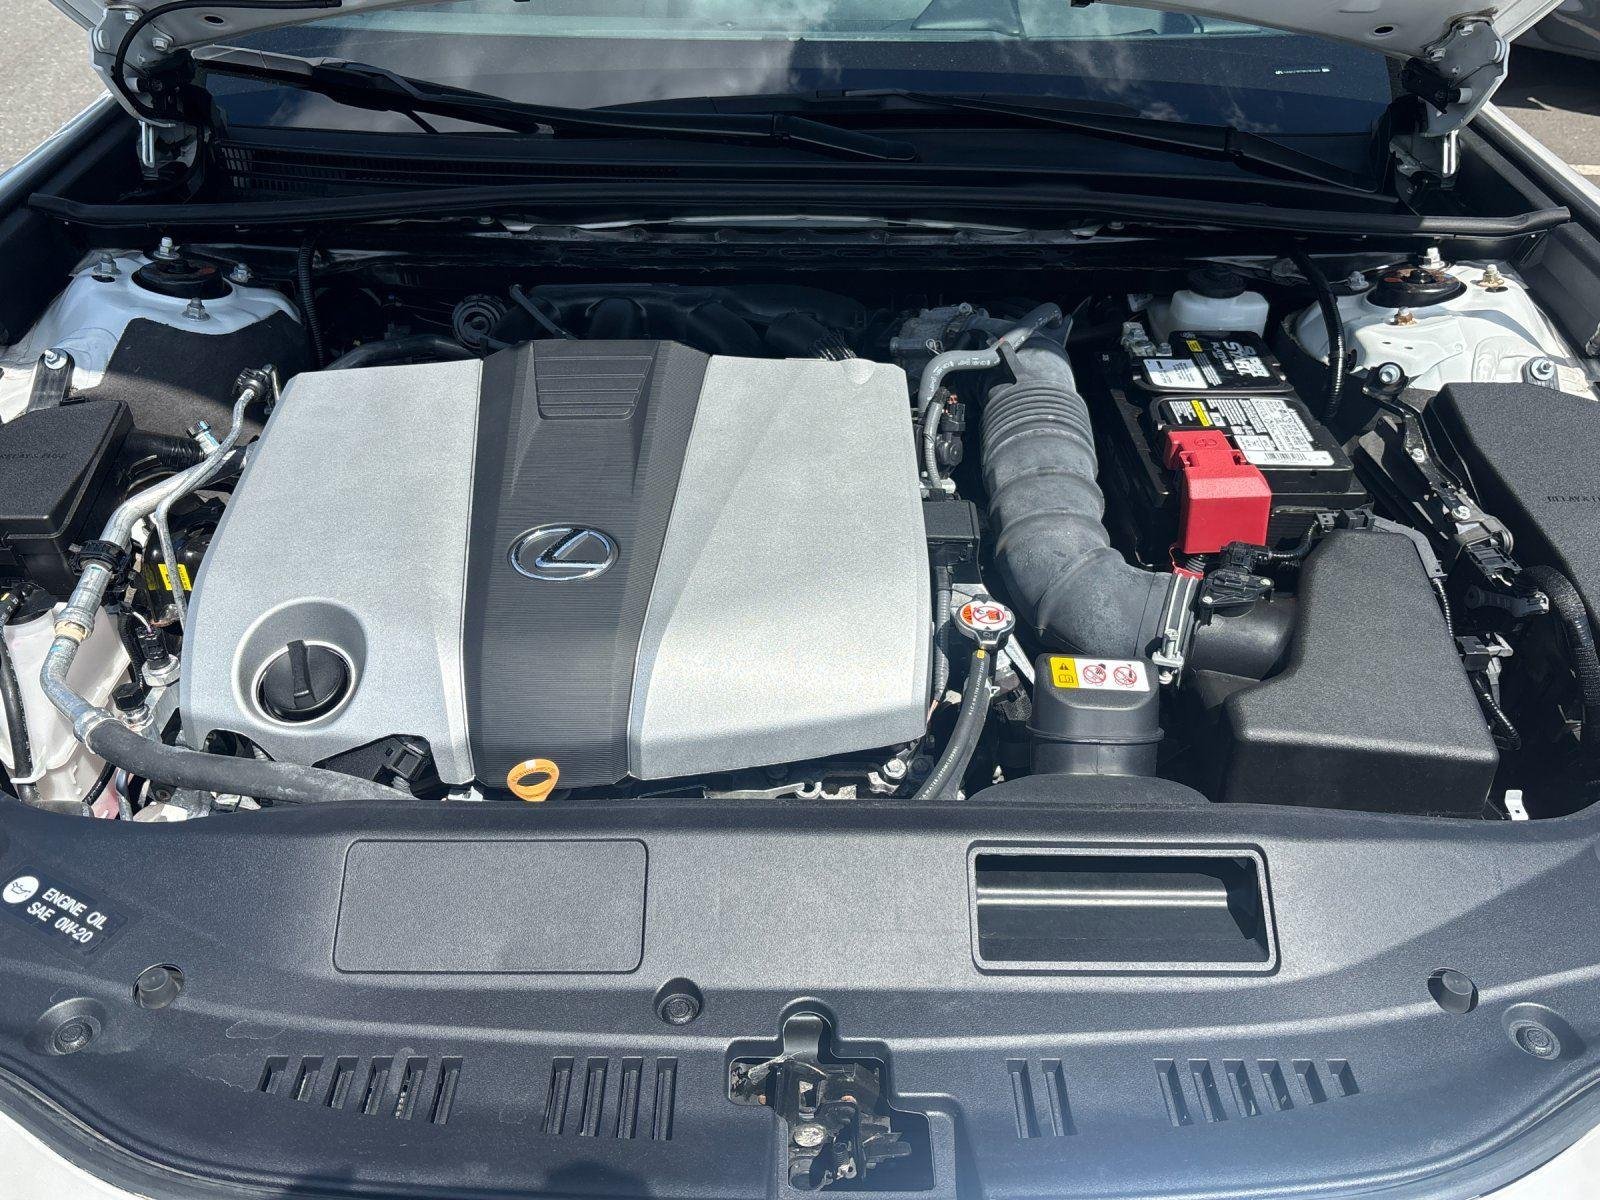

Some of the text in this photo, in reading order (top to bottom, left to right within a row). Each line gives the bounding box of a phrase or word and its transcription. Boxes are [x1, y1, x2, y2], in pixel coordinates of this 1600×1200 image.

[26, 901, 94, 943] SAE 0W-20
[42, 887, 108, 931] ENGINE OIL
